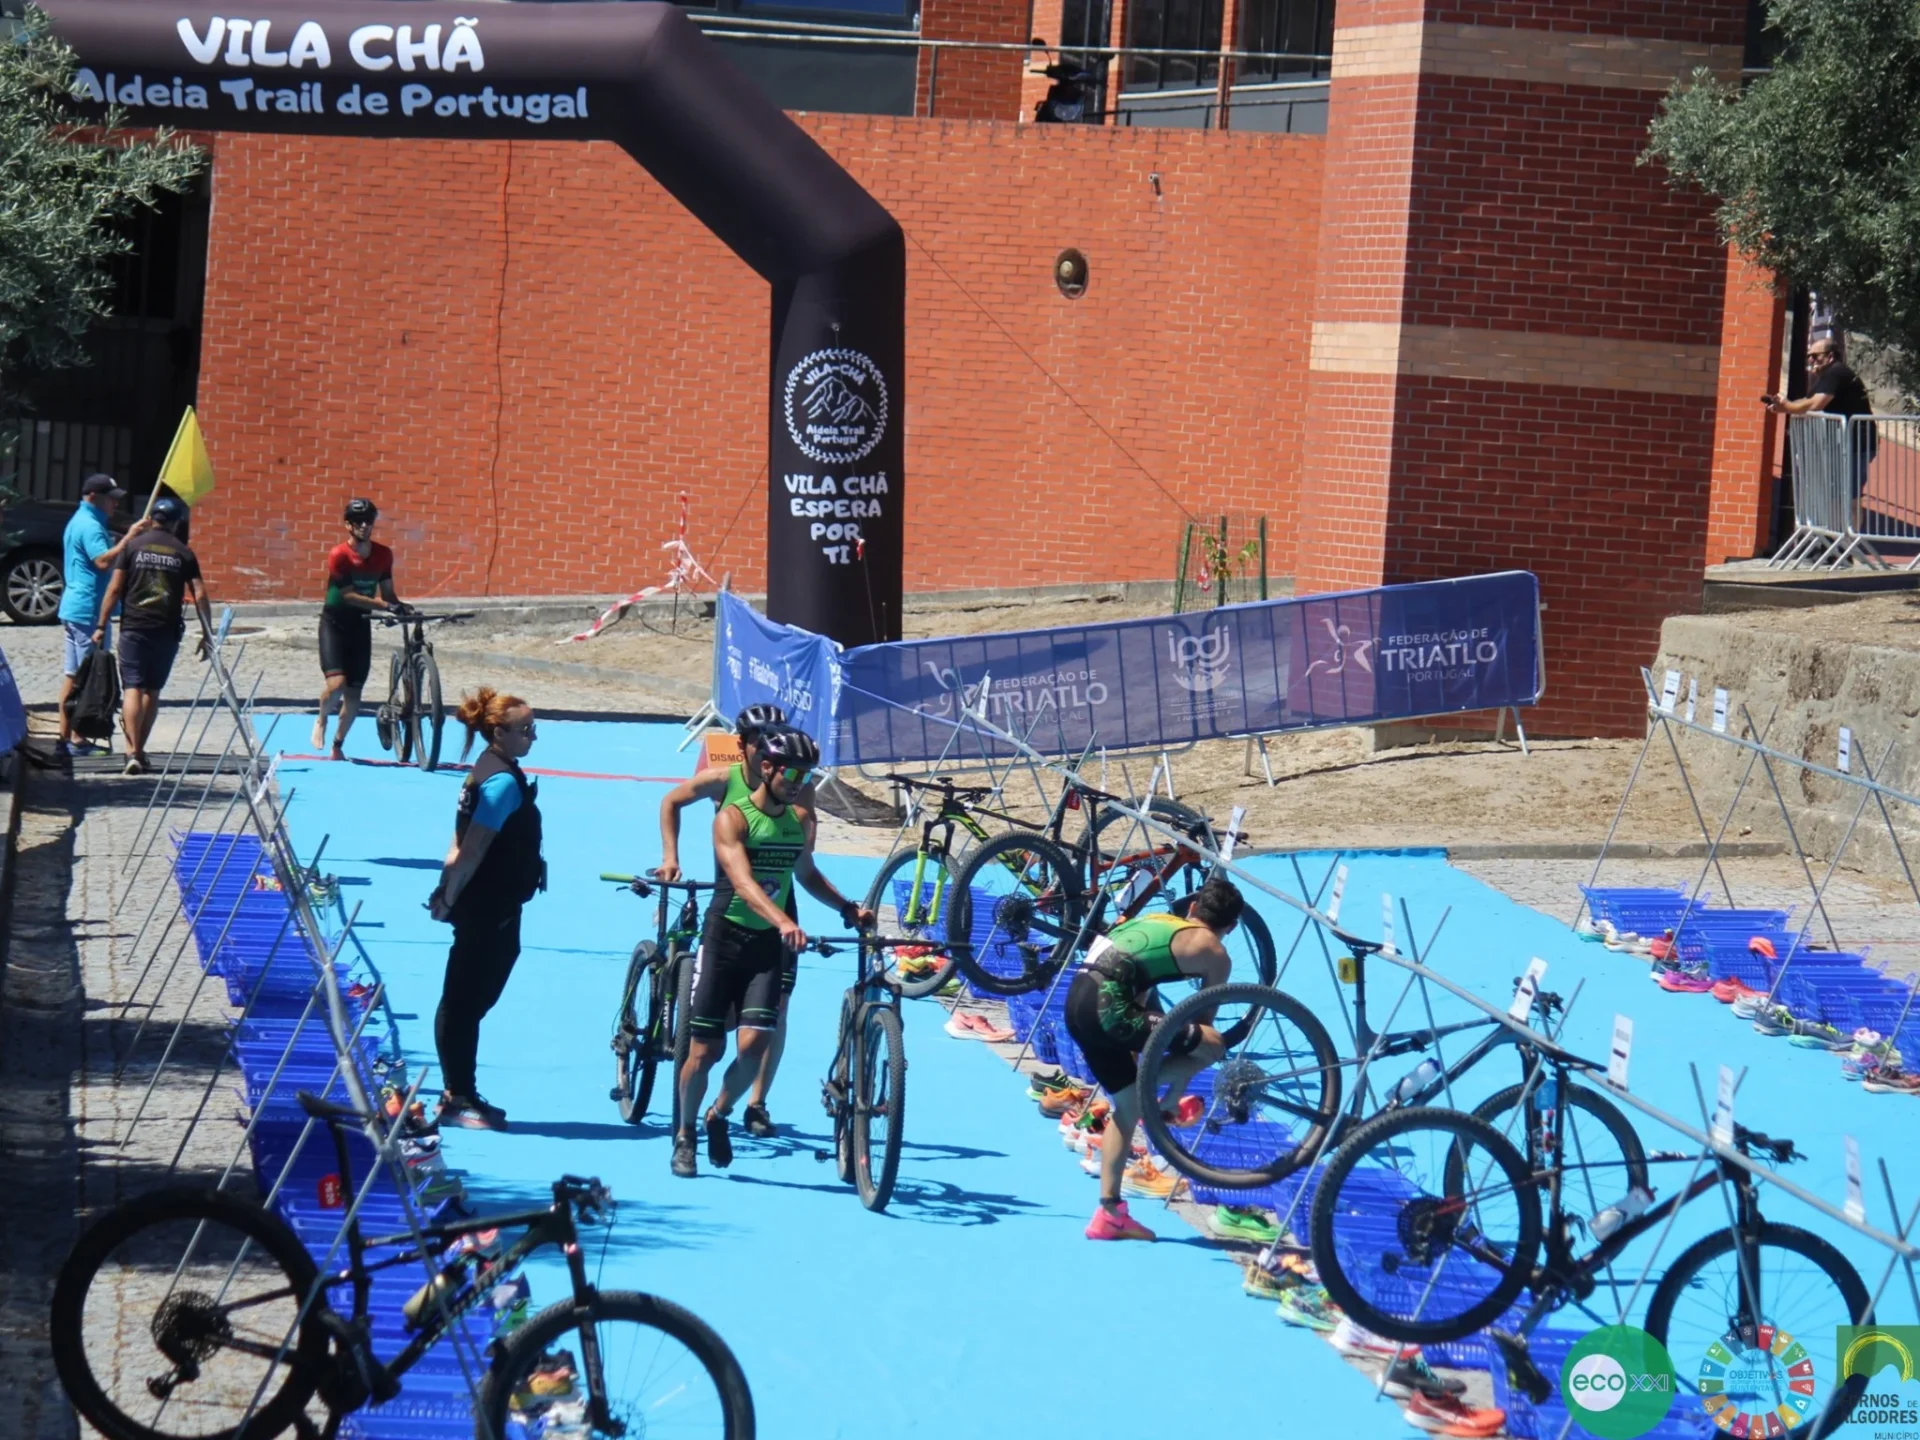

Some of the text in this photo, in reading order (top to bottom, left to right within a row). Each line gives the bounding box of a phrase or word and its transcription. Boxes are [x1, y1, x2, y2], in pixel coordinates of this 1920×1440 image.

[176, 16, 485, 73] VILA CHÃ
[72, 67, 589, 124] Aldeia Trail de Portugal
[806, 424, 865, 434] Aldeia Trail
[813, 434, 858, 446] Portugal
[784, 471, 888, 494] VILA CHÃ
[790, 498, 882, 518] ESPERA
[810, 522, 861, 541] POR
[135, 551, 181, 567] ÁRBITRO
[822, 545, 850, 564] TI
[1388, 627, 1488, 646] FEDERAÇÃO DE
[1167, 624, 1230, 669] ipdj
[1380, 640, 1498, 672] TRIATLO
[995, 669, 1097, 690] FEDERAÇÃO DE
[1407, 668, 1475, 683] PORTUGAL
[988, 682, 1108, 716] TRIATLO
[710, 752, 744, 763] DISMO
